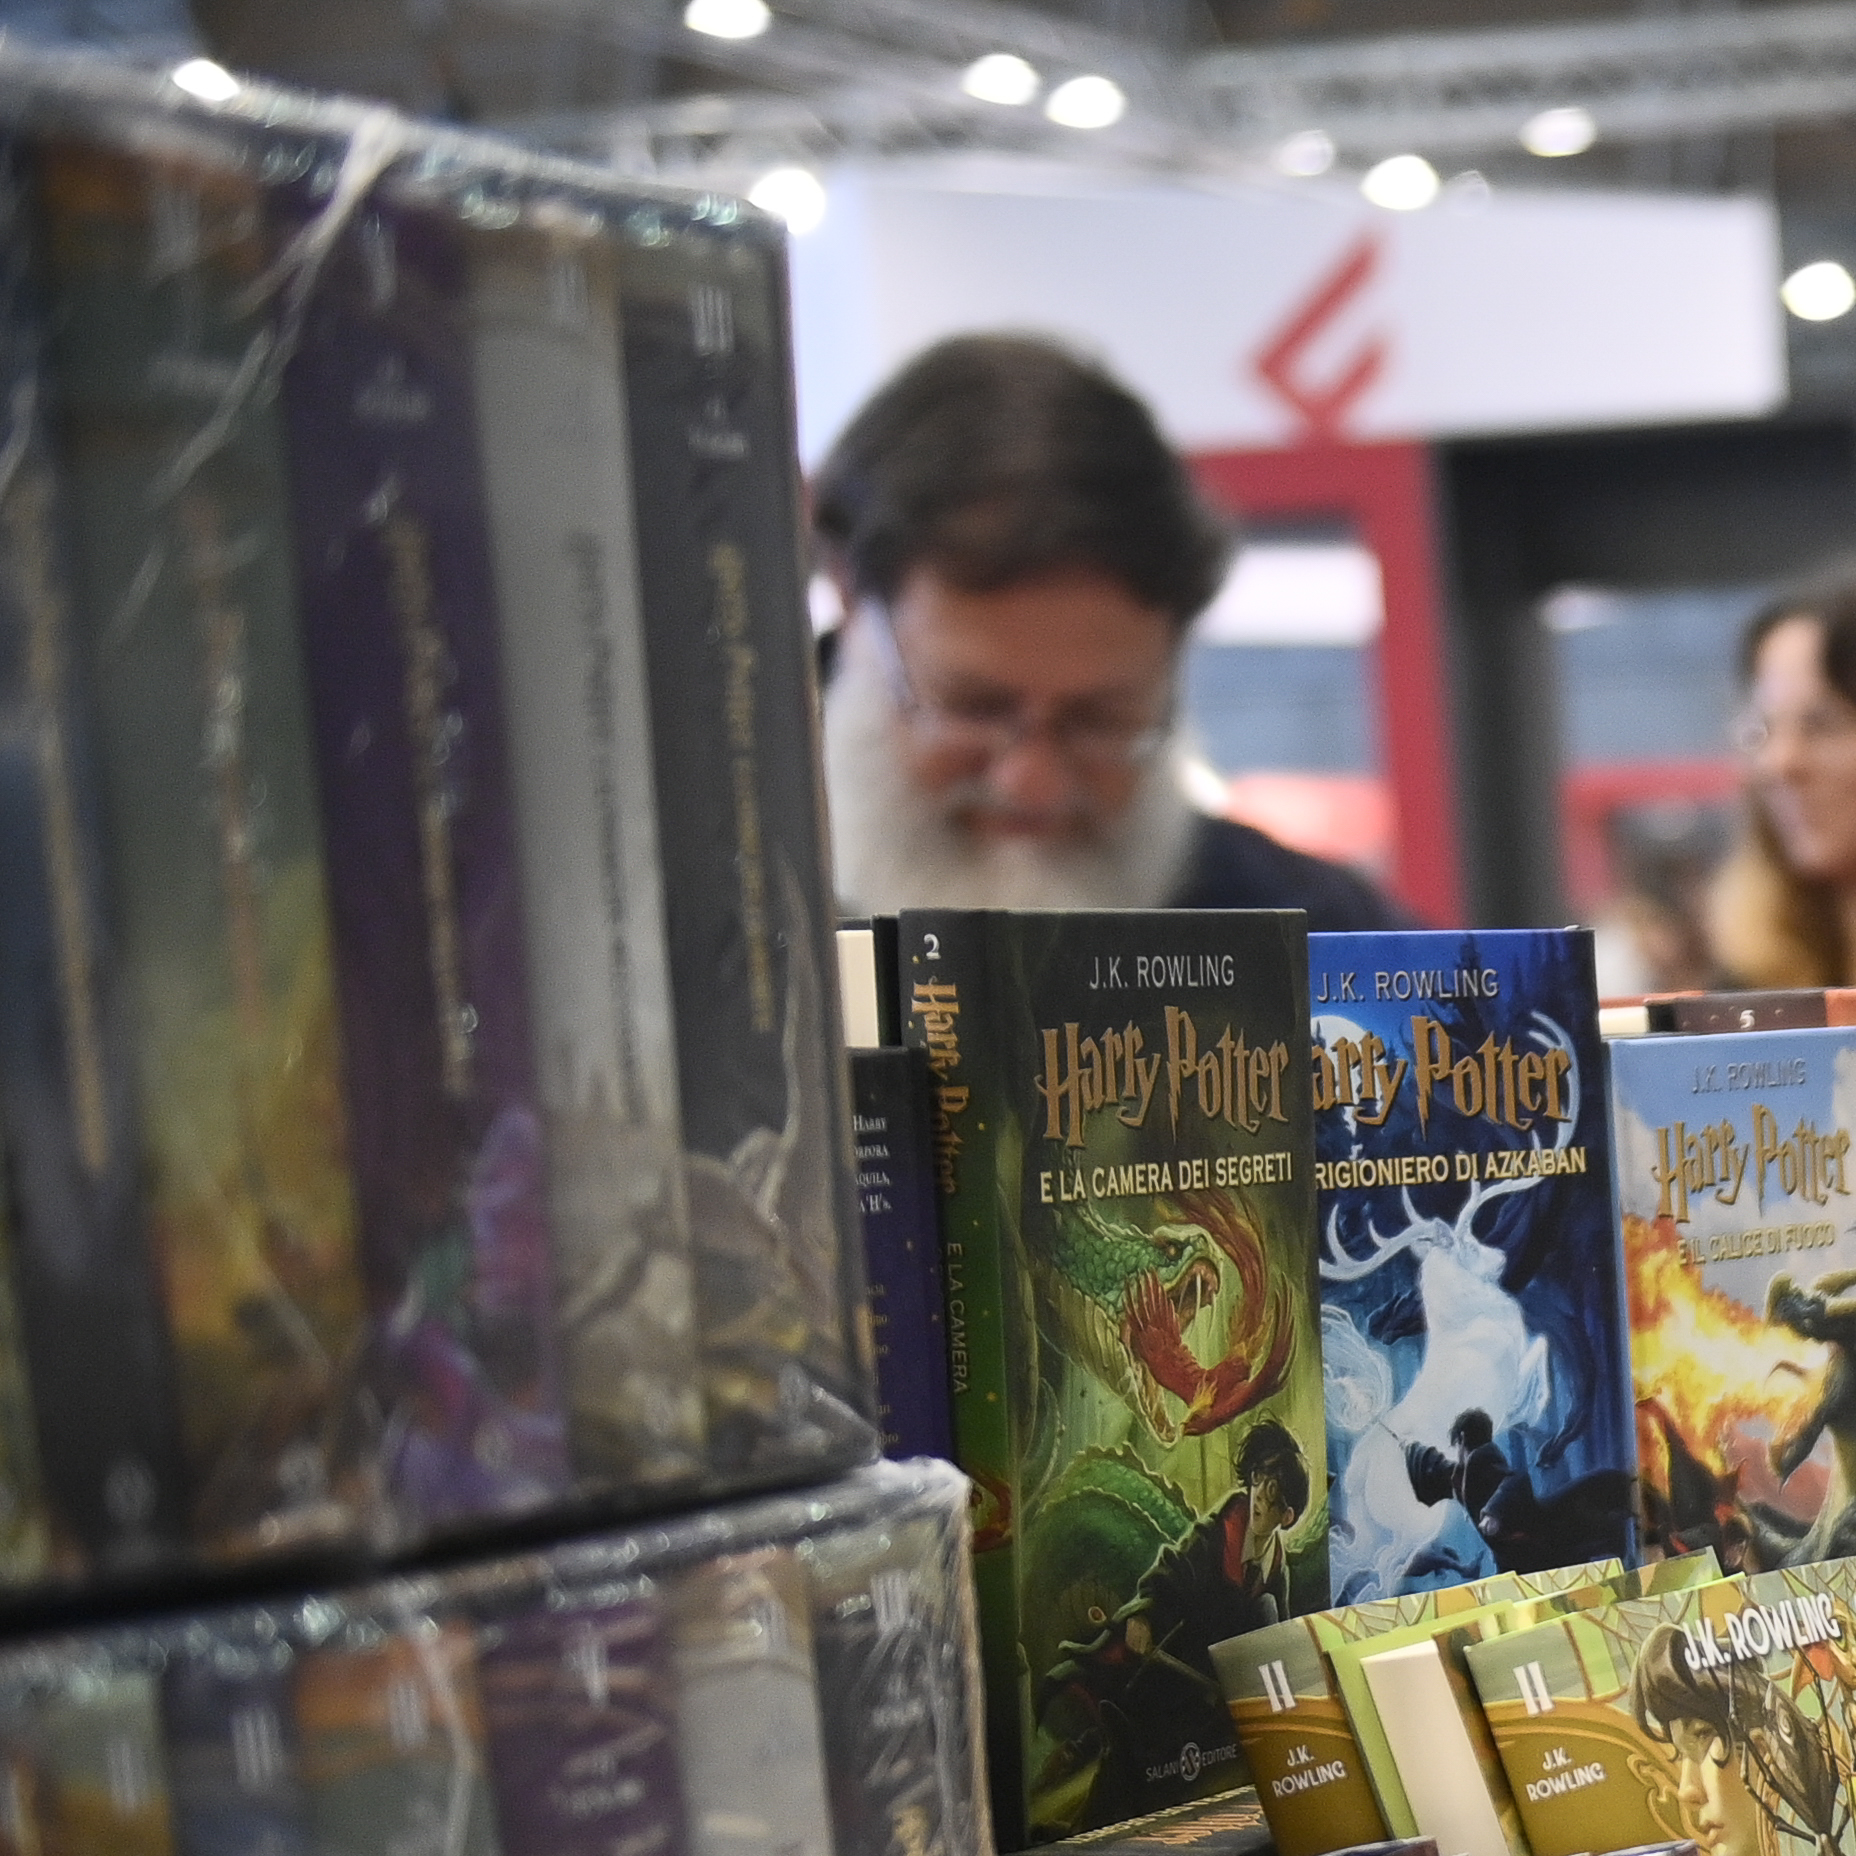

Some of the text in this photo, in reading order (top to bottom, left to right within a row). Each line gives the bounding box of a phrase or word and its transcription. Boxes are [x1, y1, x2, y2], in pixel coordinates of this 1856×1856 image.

[924, 934, 941, 959] 2
[1090, 955, 1235, 989] J.K. ROWLING
[1317, 968, 1500, 1001] J.K. ROWLING
[911, 976, 962, 1081] Harry
[1739, 1010, 1755, 1029] 5
[1034, 1005, 1289, 1149] Harry Potter
[1311, 1016, 1572, 1141] arry Potter
[1692, 1058, 1806, 1094] J.K. ROWLING
[1040, 1151, 1293, 1203] E LA CAMERA DEI SEGRETI
[1313, 1147, 1587, 1190] RIGIONIERO DI AZKABAN
[1652, 1103, 1851, 1223] Harry Potter
[1707, 1223, 1836, 1262] CALICE DI FUOCO
[947, 1263, 968, 1395] LA CAMERA
[1684, 1592, 1842, 1671] J.K. ROWLING
[1258, 1659, 1297, 1714] II
[1512, 1660, 1555, 1717] II
[1145, 1743, 1239, 1783] SALANI EDITORE
[1286, 1744, 1315, 1767] J.K.
[1541, 1747, 1573, 1773] J.K.
[1271, 1759, 1348, 1799] ROWLING
[1524, 1762, 1606, 1803] ROWLING
